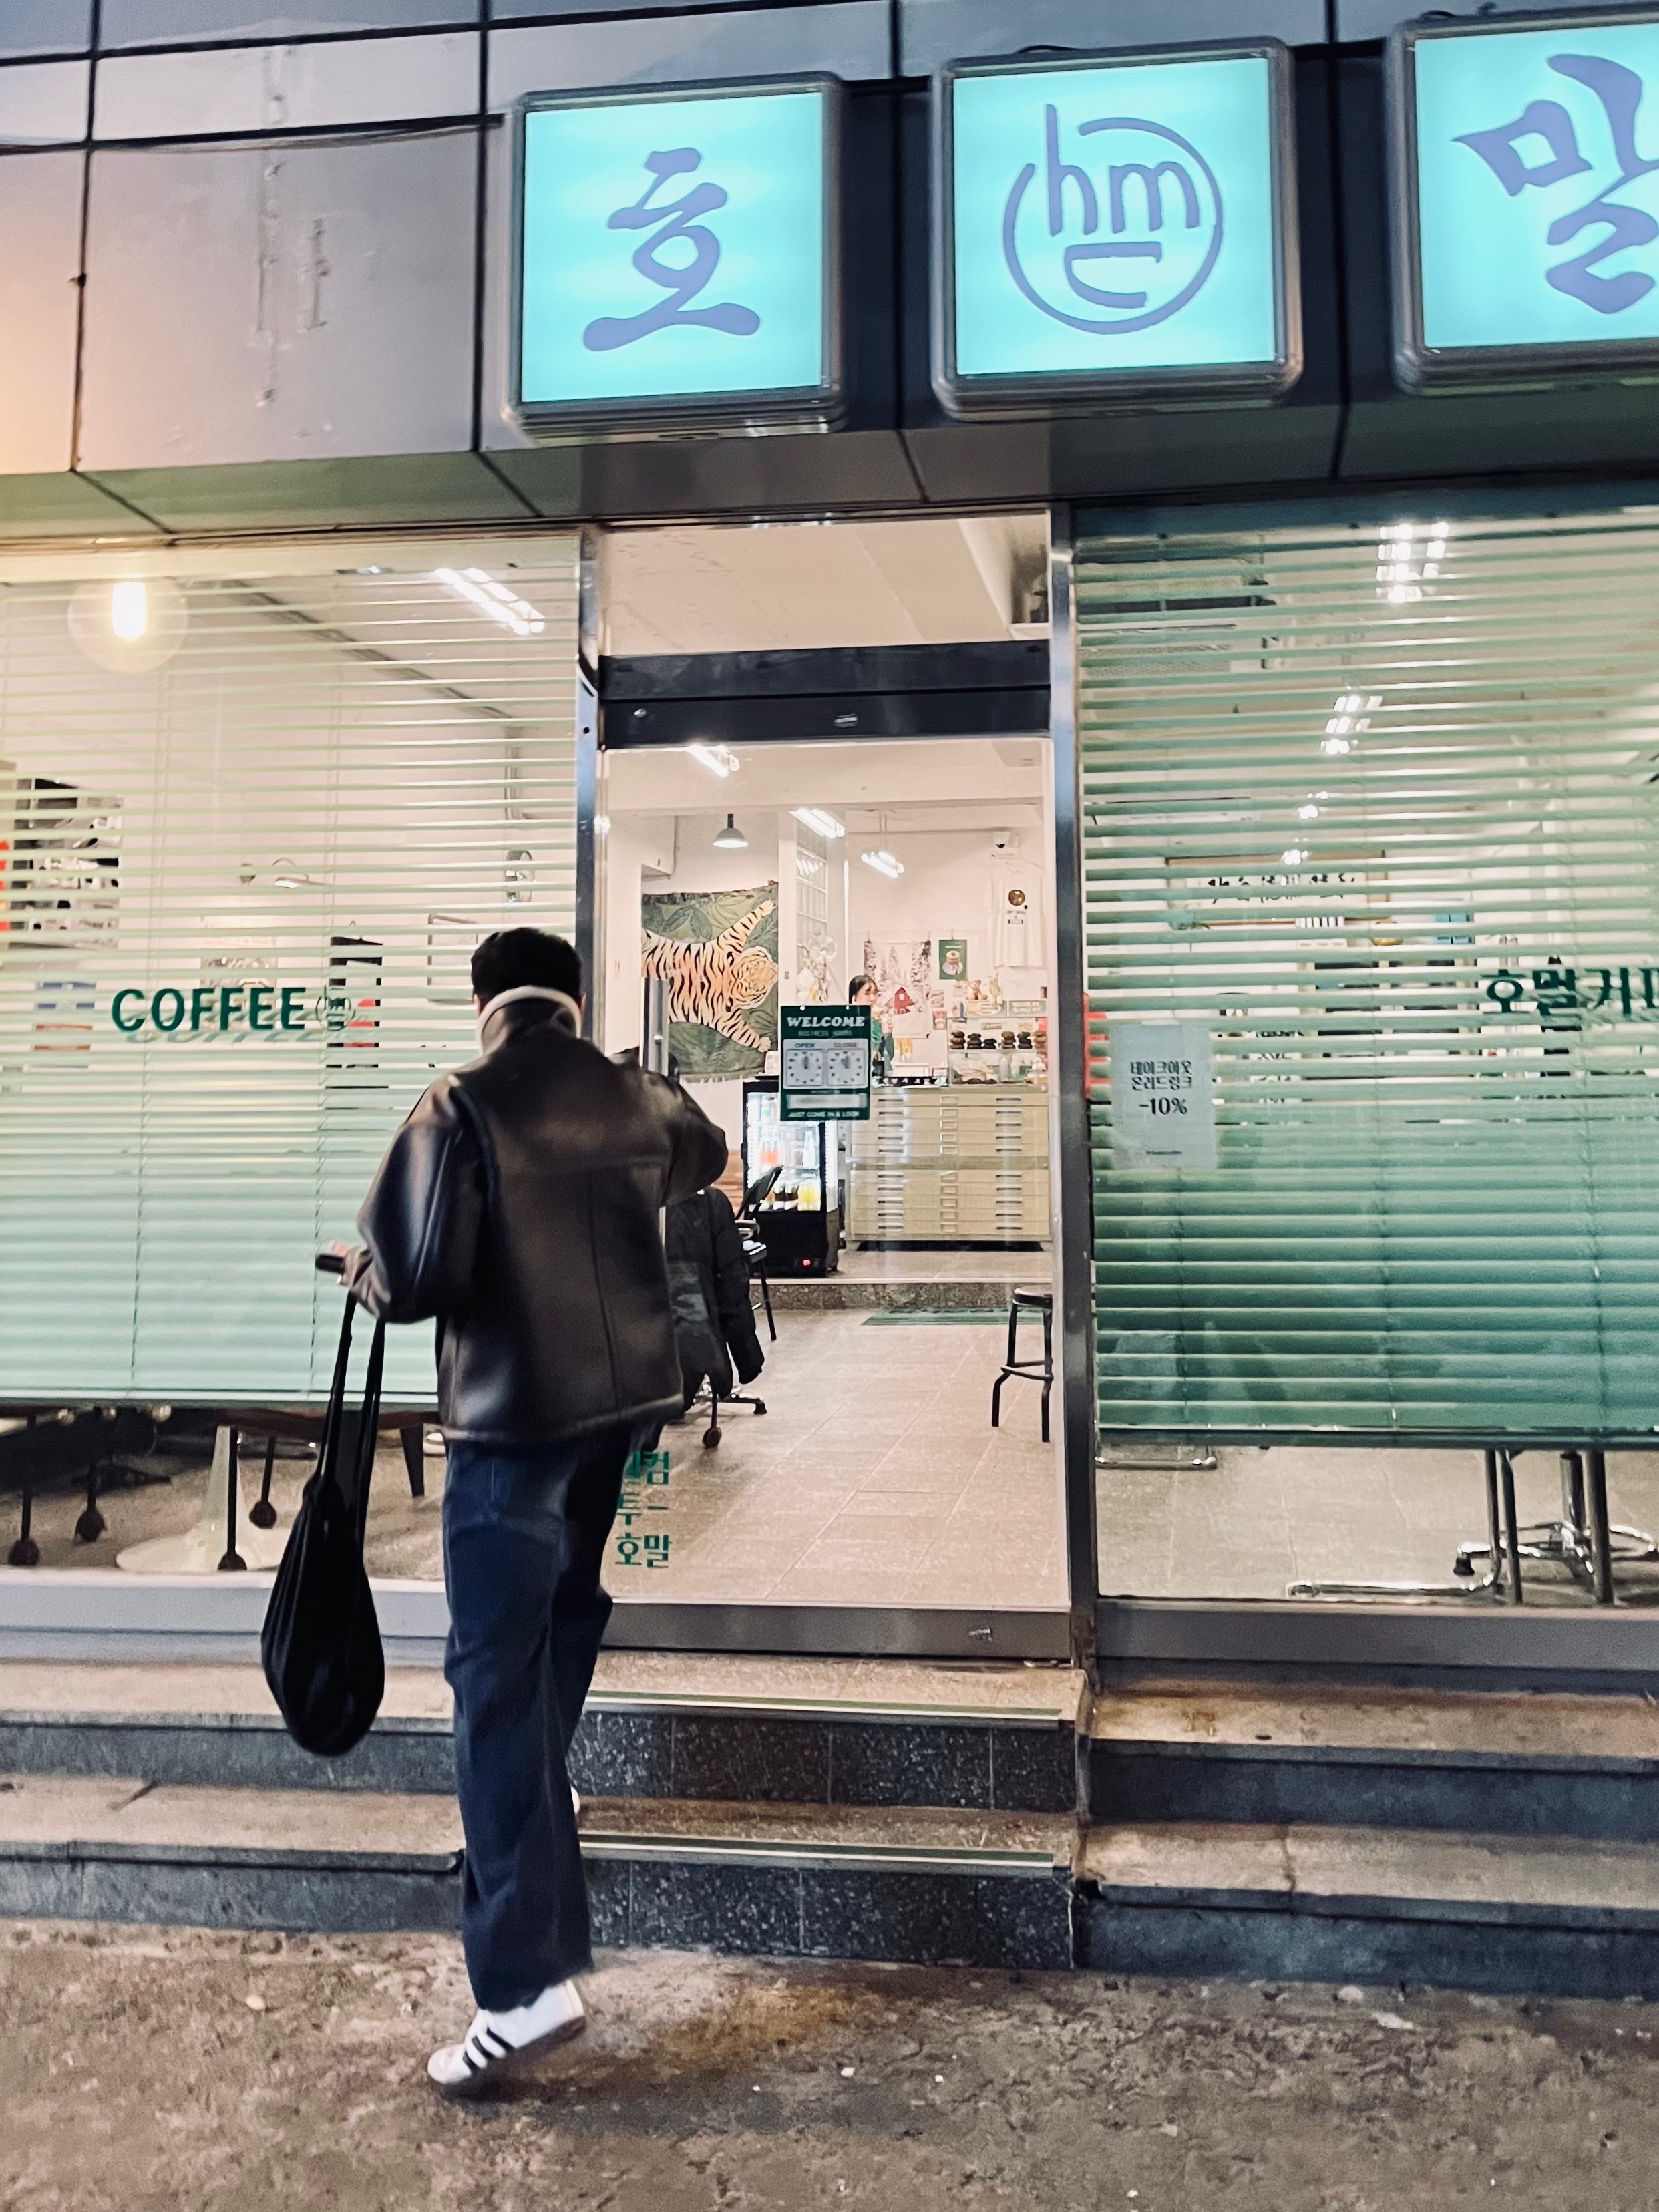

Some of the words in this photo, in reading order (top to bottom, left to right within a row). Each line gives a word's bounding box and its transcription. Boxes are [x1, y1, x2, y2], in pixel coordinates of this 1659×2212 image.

[583, 147, 760, 352] 호
[111, 986, 307, 1031] COFFEE
[787, 1016, 866, 1027] WELCOME
[1139, 1097, 1188, 1115] -10%
